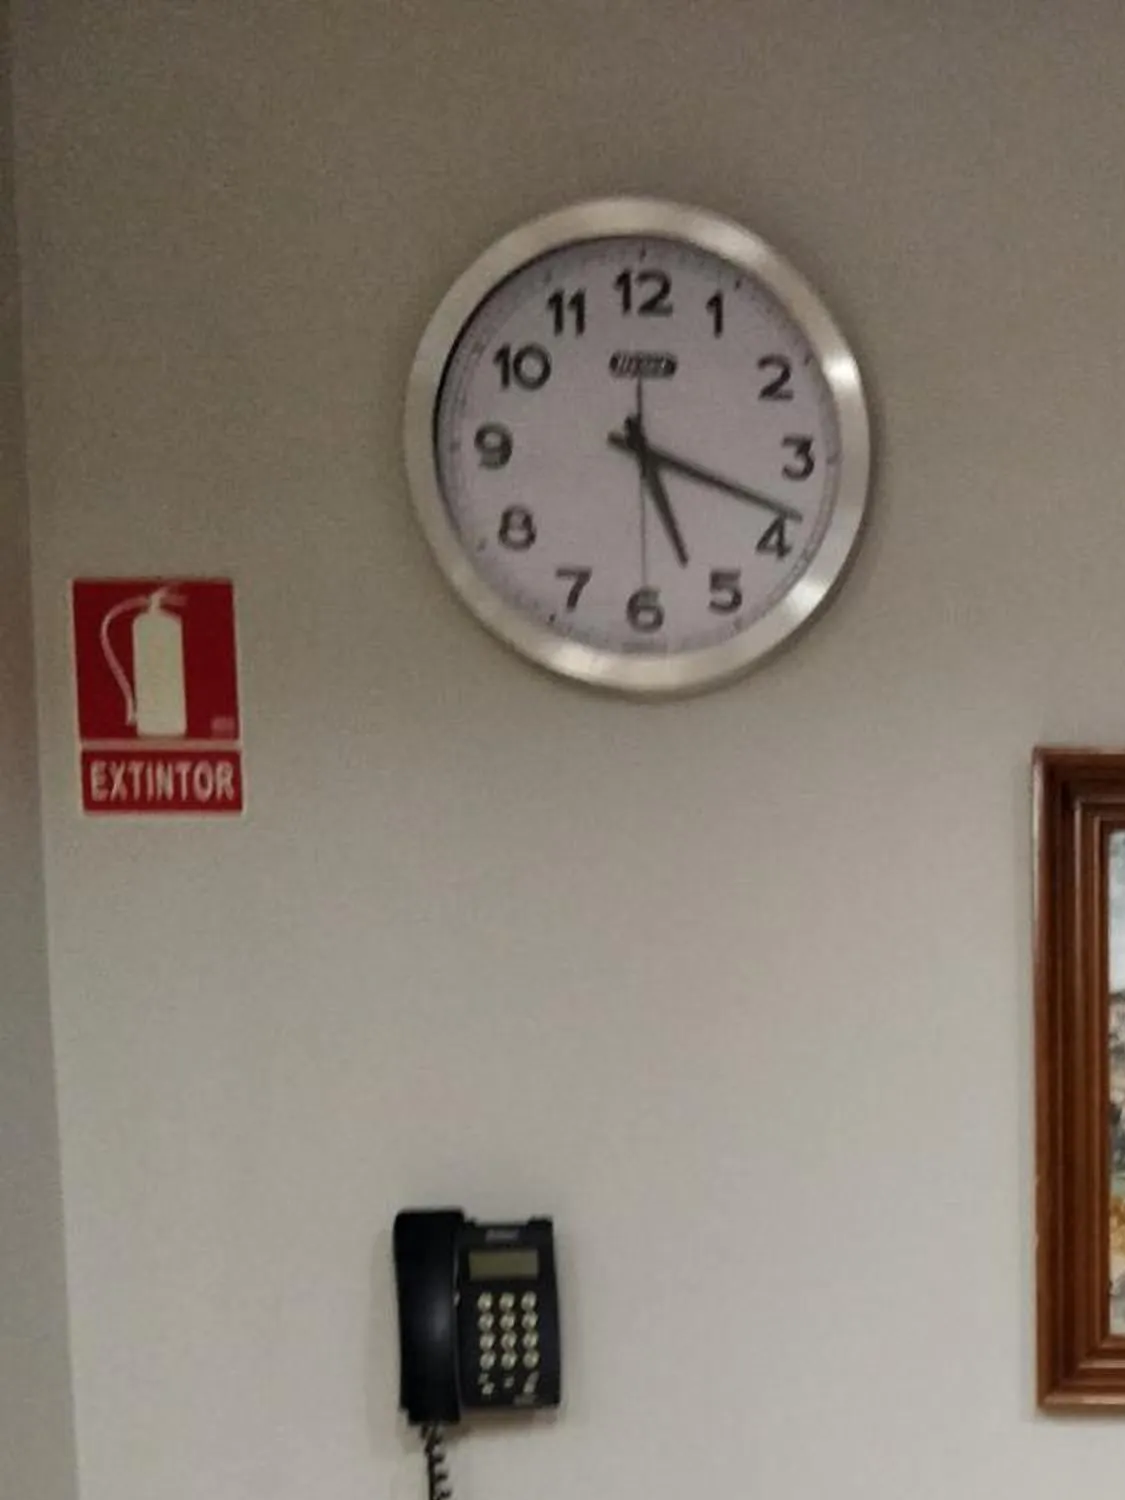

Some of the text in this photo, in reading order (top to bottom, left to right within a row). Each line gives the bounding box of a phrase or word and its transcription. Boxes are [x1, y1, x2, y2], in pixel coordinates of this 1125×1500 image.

[547, 288, 587, 335] 11
[614, 270, 674, 316] 12
[706, 291, 725, 337] 1
[493, 345, 552, 389] 10
[757, 355, 794, 400] 2
[474, 423, 513, 469] 9
[781, 434, 815, 481] 3
[498, 506, 536, 552] 8
[755, 513, 792, 560] 4
[555, 567, 592, 612] 7
[626, 586, 664, 632] 6
[709, 570, 742, 614] 5
[90, 760, 234, 802] EXTINTOR
